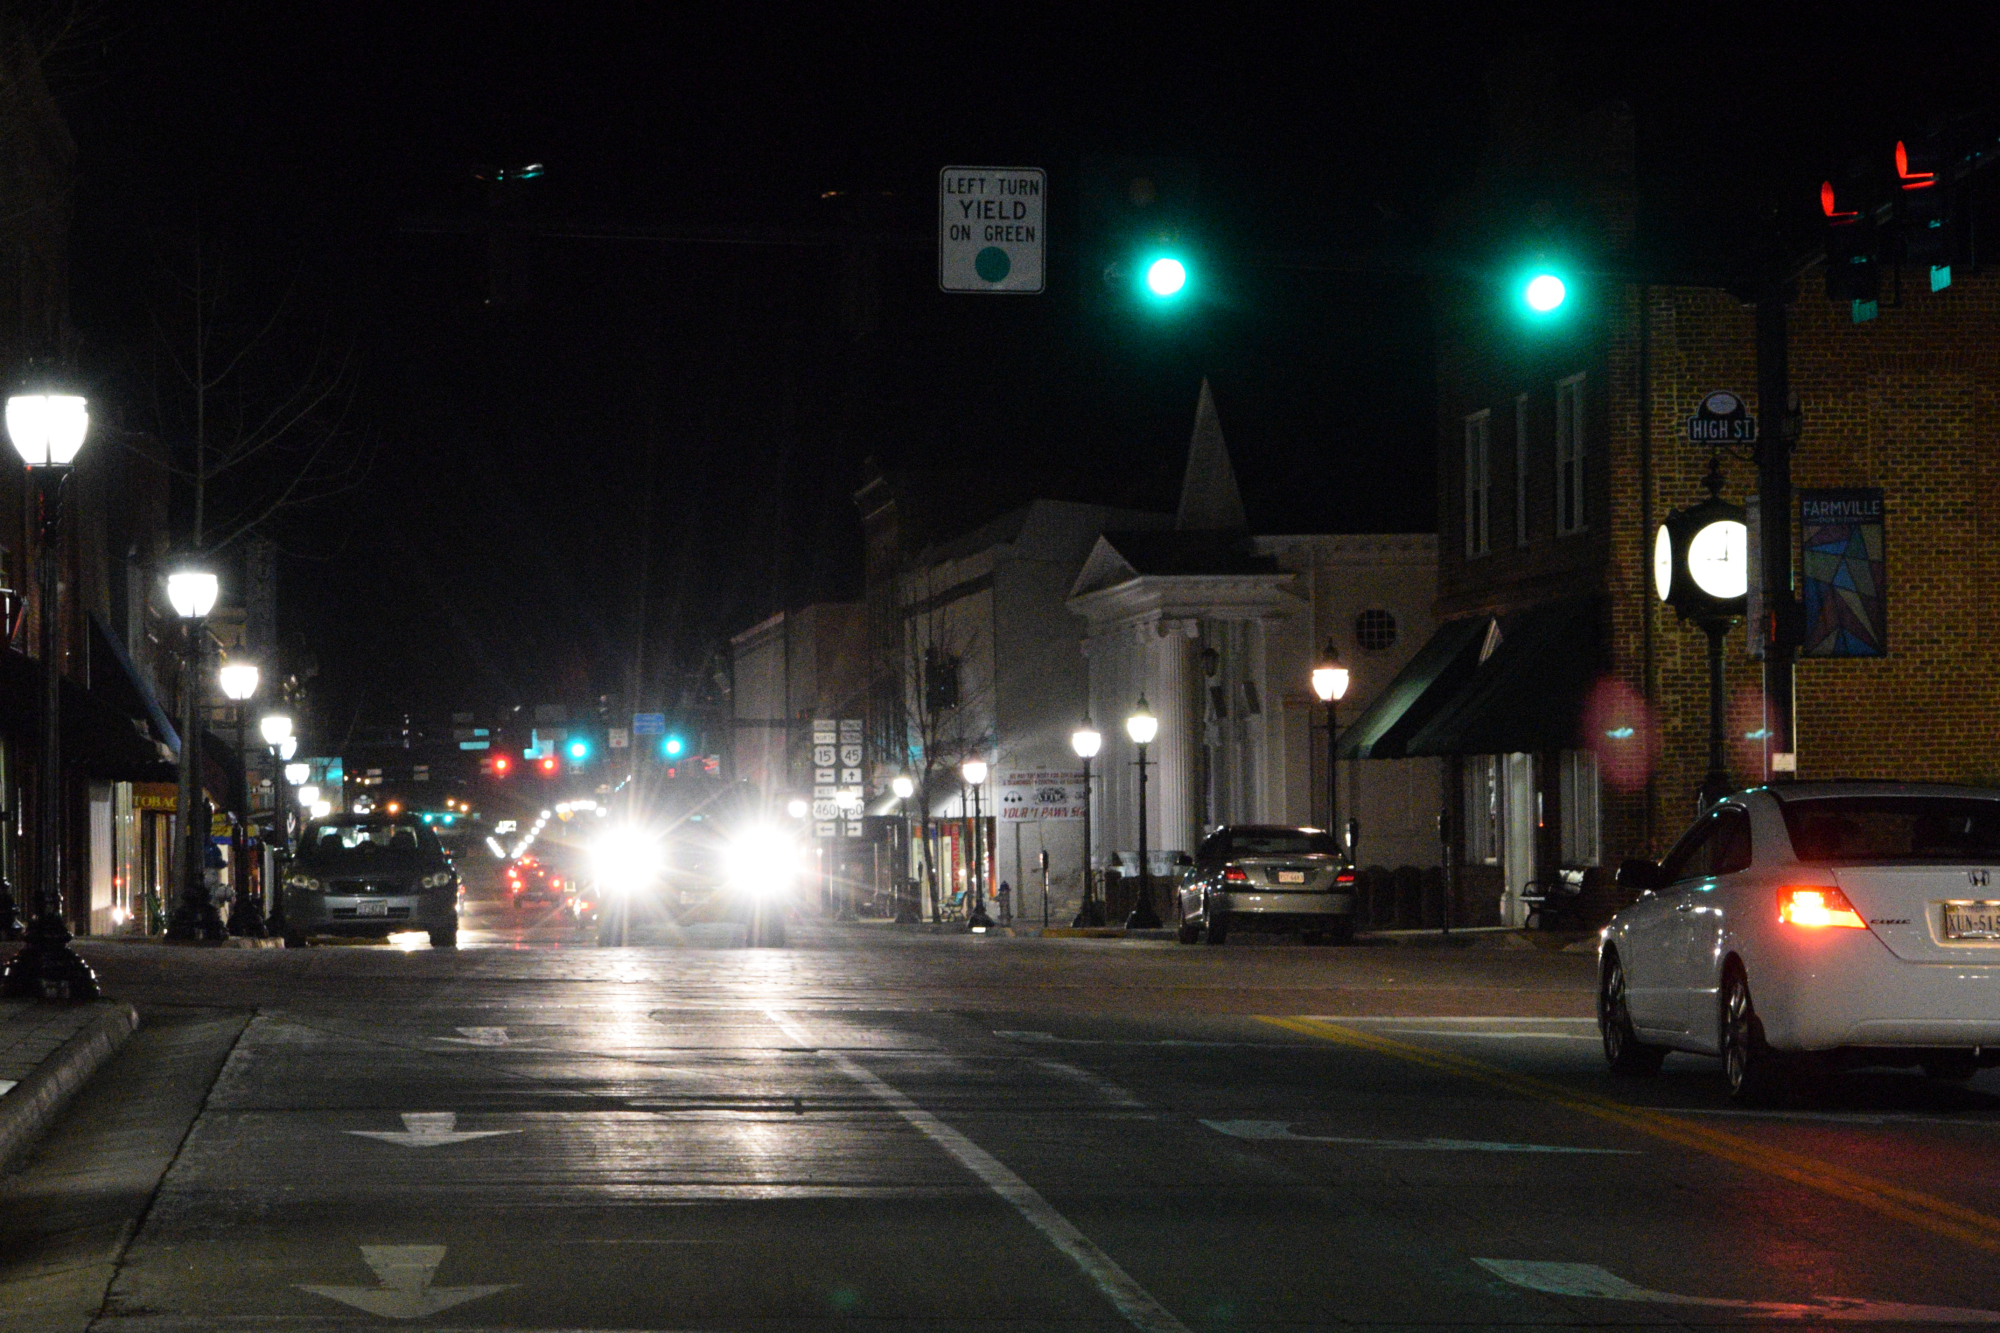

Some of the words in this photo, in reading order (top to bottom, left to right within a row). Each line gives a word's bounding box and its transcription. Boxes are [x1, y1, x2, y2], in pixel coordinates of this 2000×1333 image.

[947, 178, 986, 194] LEFT
[999, 179, 1039, 195] TURN
[960, 200, 1027, 219] YIELD
[950, 225, 971, 240] ON
[984, 225, 1036, 242] GREEN
[1693, 420, 1729, 439] HIGH
[1734, 420, 1751, 439] ST
[1803, 500, 1880, 515] FARMVILLE
[819, 750, 831, 762] 15
[845, 749, 860, 762] 45
[133, 796, 177, 807] TOBAC
[816, 804, 836, 815] 460
[1003, 807, 1028, 818] YOUR
[1041, 808, 1068, 818] PAWN
